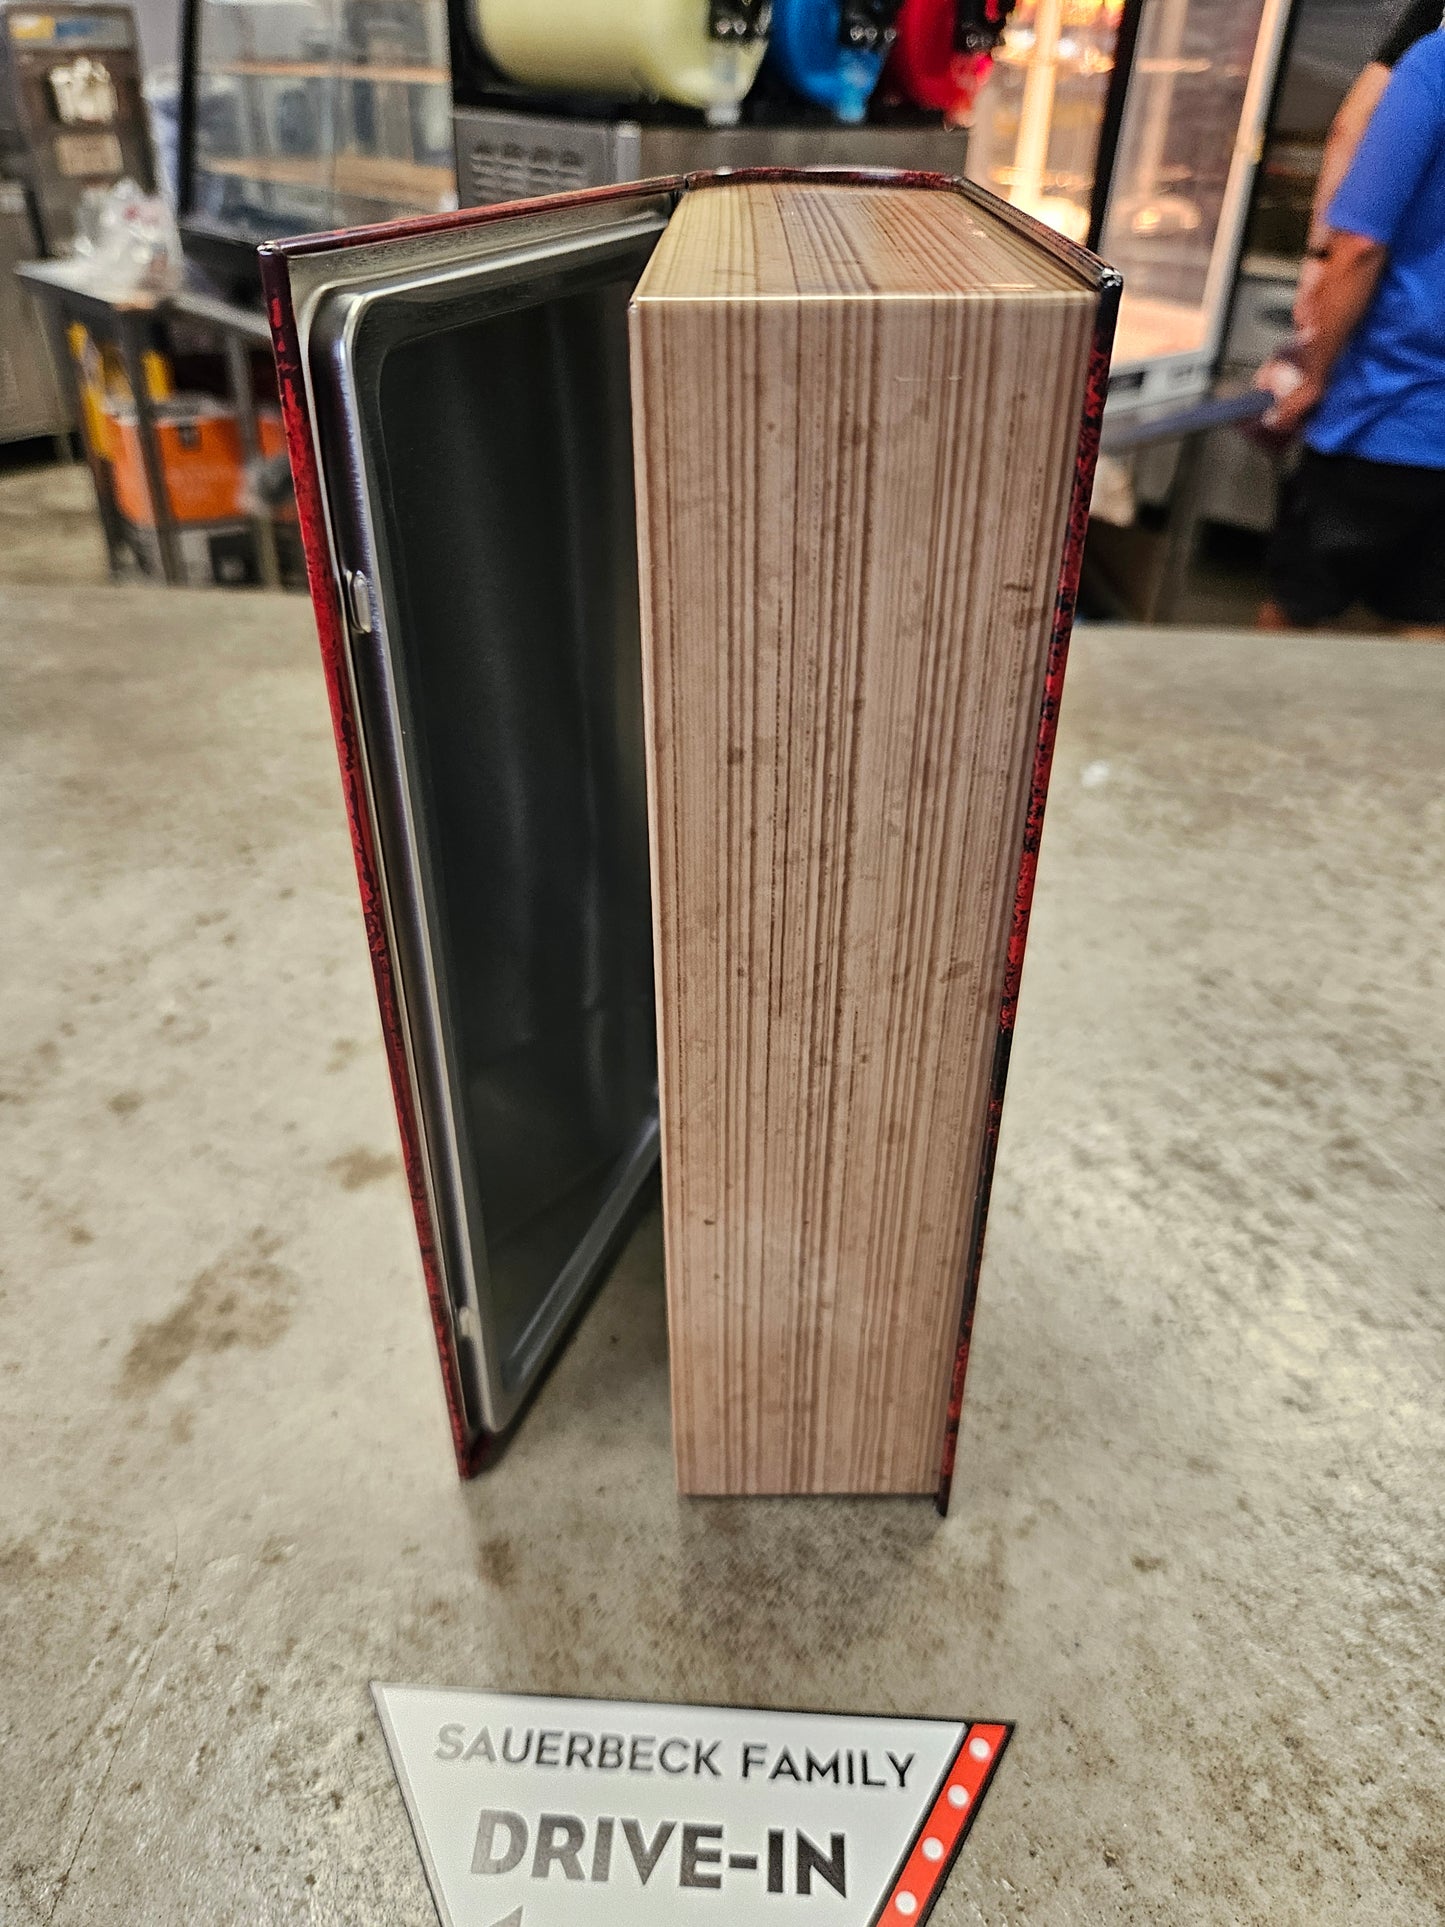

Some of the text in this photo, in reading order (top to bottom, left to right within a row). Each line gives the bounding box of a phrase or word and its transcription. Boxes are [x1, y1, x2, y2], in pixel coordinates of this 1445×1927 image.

[435, 1723, 916, 1789] SAUERBECK FAMILY
[471, 1809, 848, 1899] DRIVE-IN
